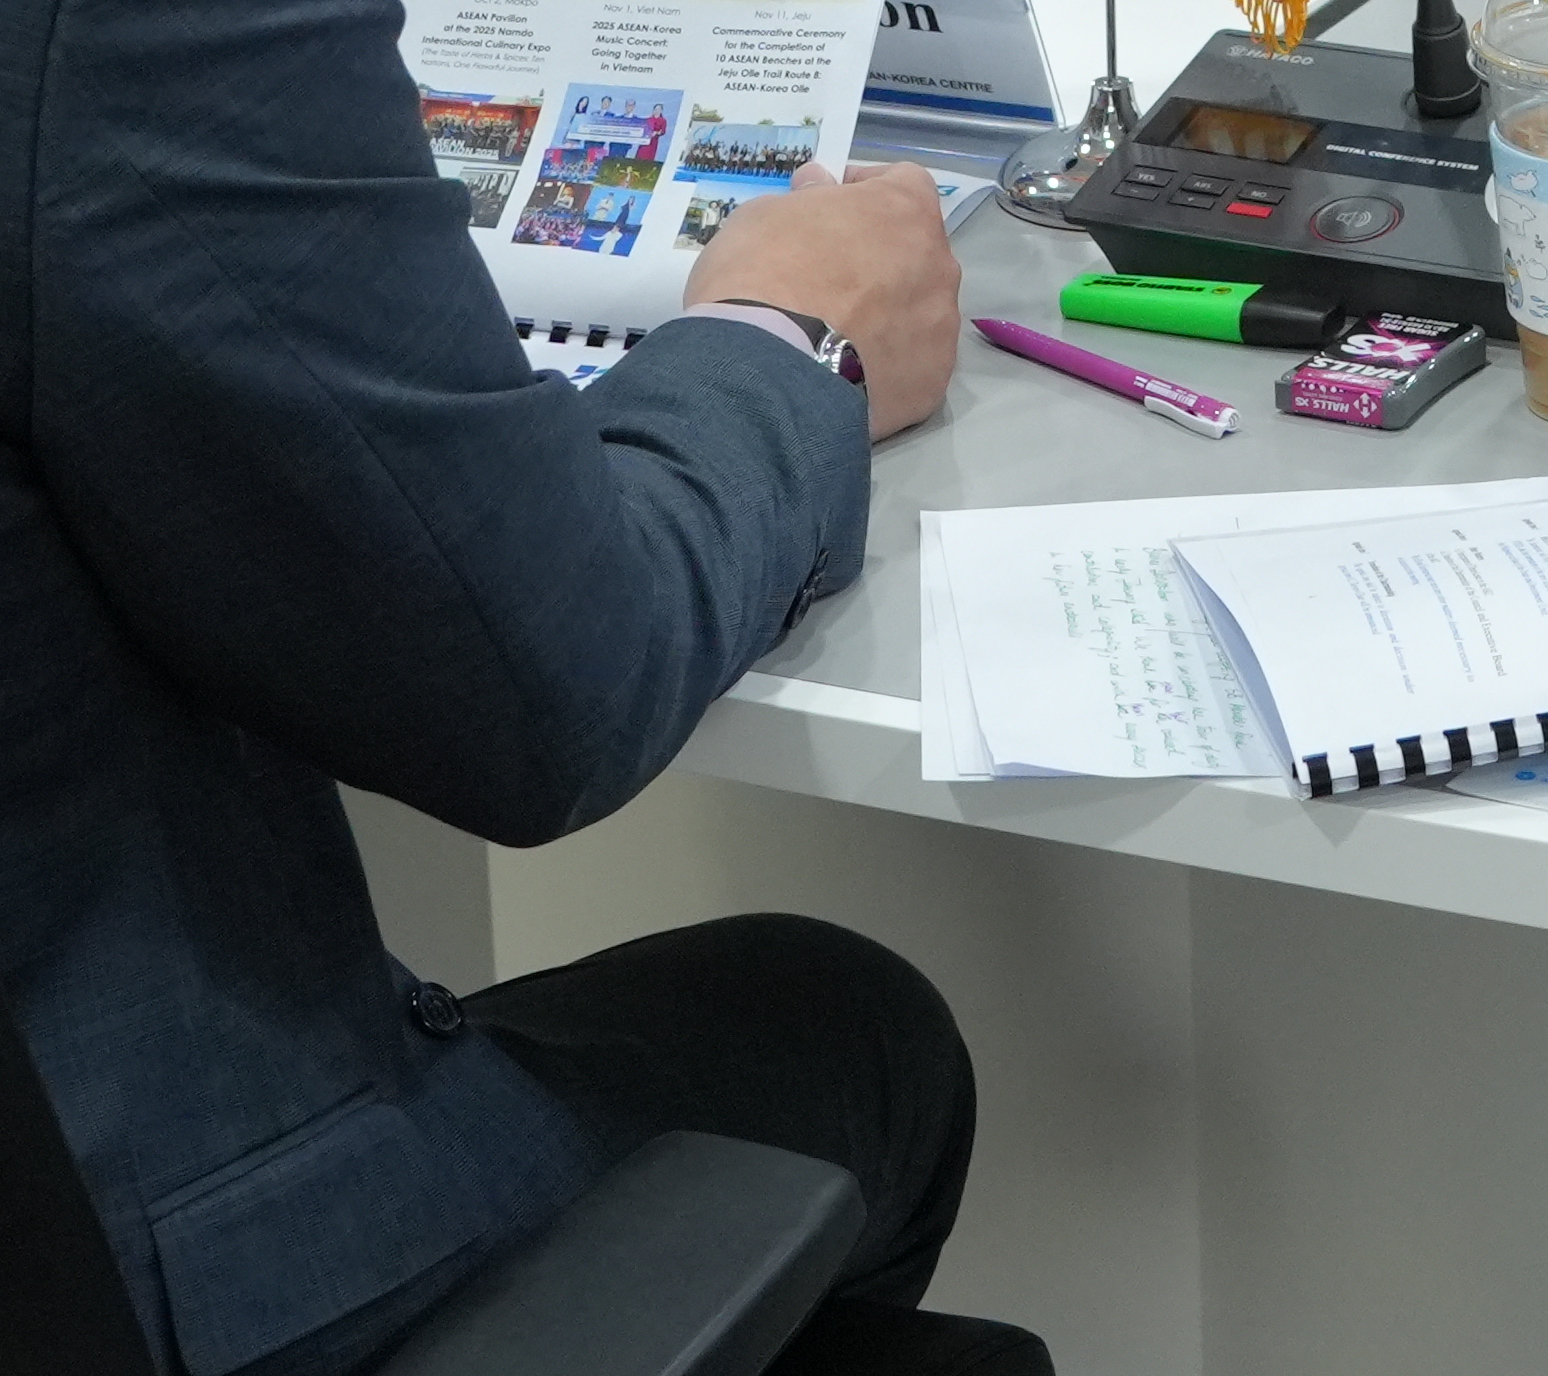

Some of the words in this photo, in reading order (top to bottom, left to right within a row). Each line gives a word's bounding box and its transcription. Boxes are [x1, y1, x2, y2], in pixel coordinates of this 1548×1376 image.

[604, 3, 623, 13] Nov
[636, 5, 655, 16] Viet
[657, 6, 681, 16] Nam
[754, 10, 773, 19] Nov
[792, 11, 811, 22] Jeju
[457, 11, 488, 21] ASEAN
[491, 13, 528, 24] Pavilion
[444, 24, 454, 32] at
[456, 24, 471, 34] the
[472, 25, 496, 36] 2025
[498, 27, 534, 38] Namdo
[592, 21, 615, 31] 2025
[617, 22, 682, 35] ASEAN-Korea
[712, 26, 793, 38] Commemorative
[796, 28, 847, 40] Ceremony
[422, 35, 483, 49] International
[485, 39, 525, 53] Culinary
[527, 43, 551, 54] Expo
[595, 35, 624, 46] Music
[626, 37, 669, 48] Concert:
[724, 40, 738, 50] for
[740, 41, 755, 51] the
[757, 41, 814, 53] Completion
[815, 43, 826, 52] of
[591, 48, 621, 61] Going
[623, 50, 667, 62] Together
[715, 54, 726, 63] 10
[728, 54, 760, 64] ASEAN
[762, 56, 802, 66] Benches
[804, 57, 815, 66] at
[816, 57, 832, 66] the
[600, 62, 611, 72] in
[613, 63, 653, 74] Vietnam
[718, 68, 739, 79] Jeju
[741, 68, 761, 79] Olle
[763, 69, 782, 79] Trail
[784, 70, 811, 80] Route
[723, 82, 789, 94] ASEAN-Korea
[791, 84, 810, 94] Olle
[939, 79, 995, 94] CENTRE
[1325, 142, 1366, 156] DIGITAL
[1367, 150, 1436, 167] CONFERENCE
[1436, 159, 1480, 172] SYSTEM
[1136, 171, 1155, 182] YES
[1251, 190, 1268, 200] NO
[1308, 355, 1411, 380] HALLS
[1313, 399, 1350, 413] HALLS
[1480, 622, 1499, 653] Executive
[1491, 654, 1507, 676] Board
